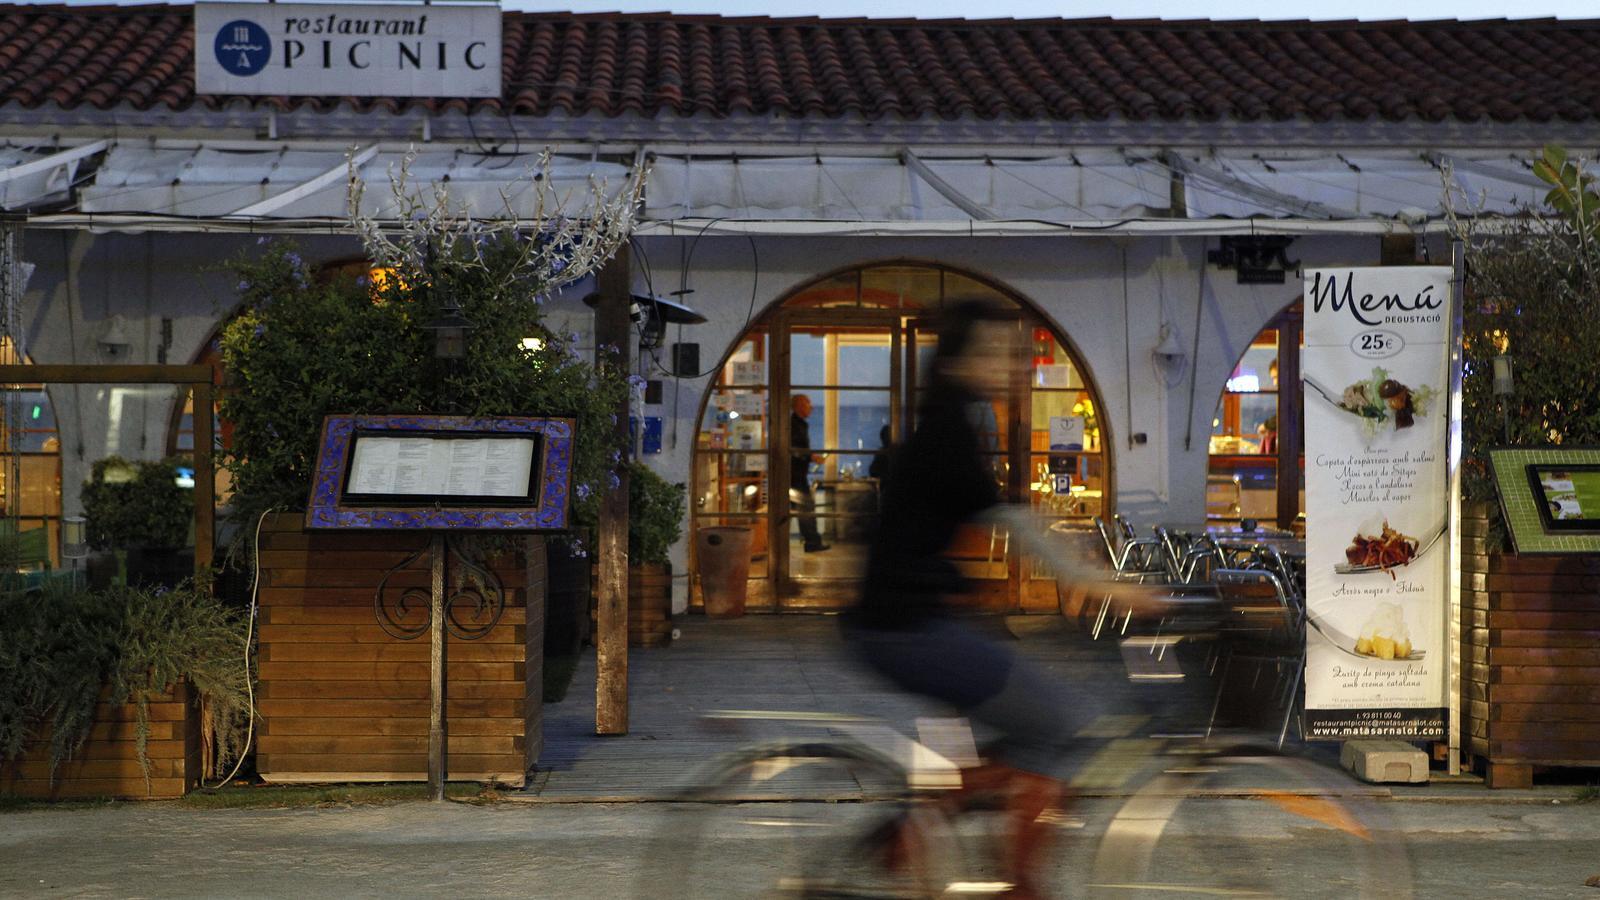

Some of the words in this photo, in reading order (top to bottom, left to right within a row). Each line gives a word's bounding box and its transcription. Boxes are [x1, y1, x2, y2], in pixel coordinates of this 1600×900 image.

[285, 15, 427, 35] restaurant
[1310, 271, 1442, 326] Menú
[1385, 314, 1441, 324] DEGUSTACIÓ
[1361, 334, 1393, 350] 25€
[1392, 451, 1409, 463] amb
[1335, 465, 1360, 480] Mini
[1380, 465, 1389, 476] de
[1391, 464, 1417, 479] Sitges
[1363, 587, 1384, 597] negre
[1363, 667, 1372, 676] de
[1374, 668, 1396, 680] pinya
[1342, 679, 1358, 689] amb
[1386, 678, 1421, 688] catalana
[1313, 719, 1444, 728] restaurantpicnic@matasarnalot.com
[1313, 726, 1444, 736] www.matasarnalot.com
